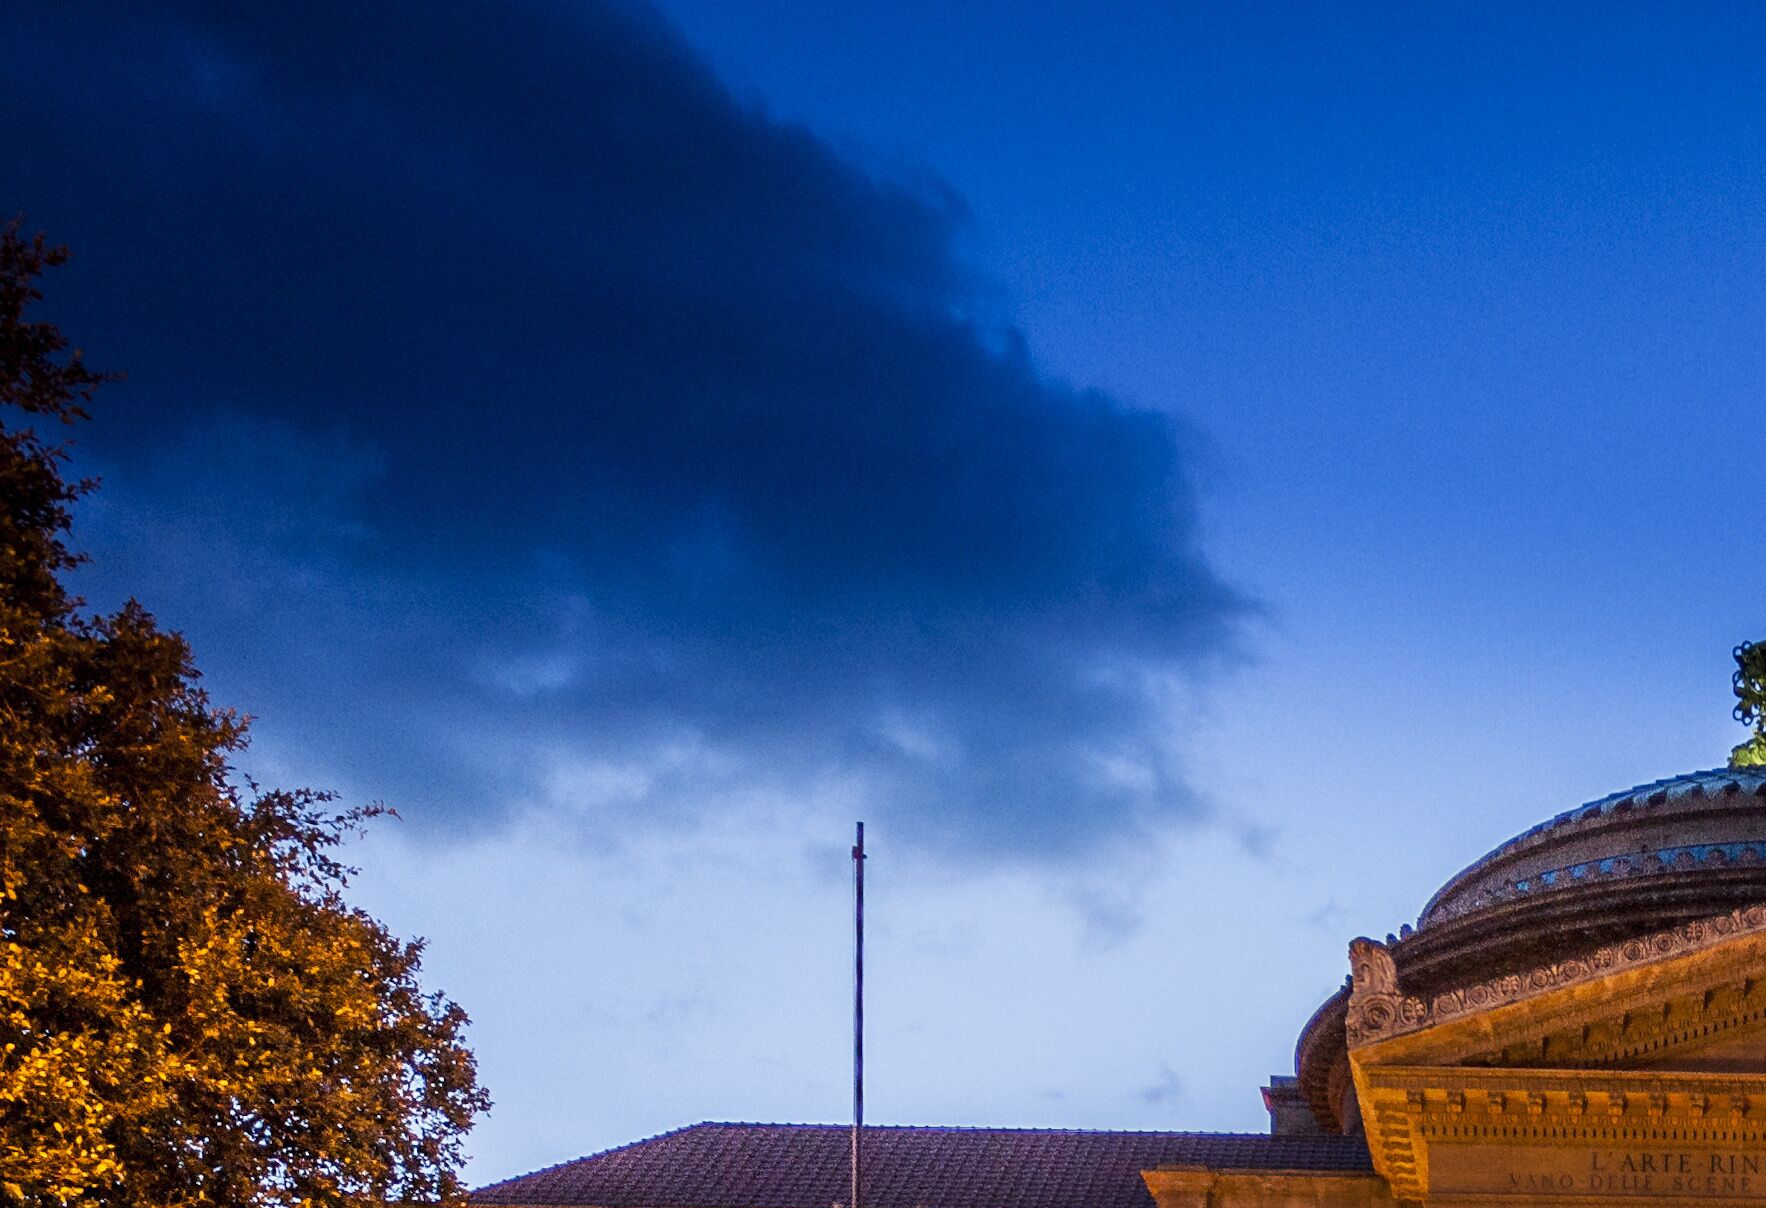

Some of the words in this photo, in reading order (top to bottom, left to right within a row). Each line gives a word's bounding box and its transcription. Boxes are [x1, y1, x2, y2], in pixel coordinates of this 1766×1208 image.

[1508, 1170, 1574, 1189] VANO
[1589, 1173, 1654, 1191] DELLE
[1672, 1175, 1754, 1193] SCENE
